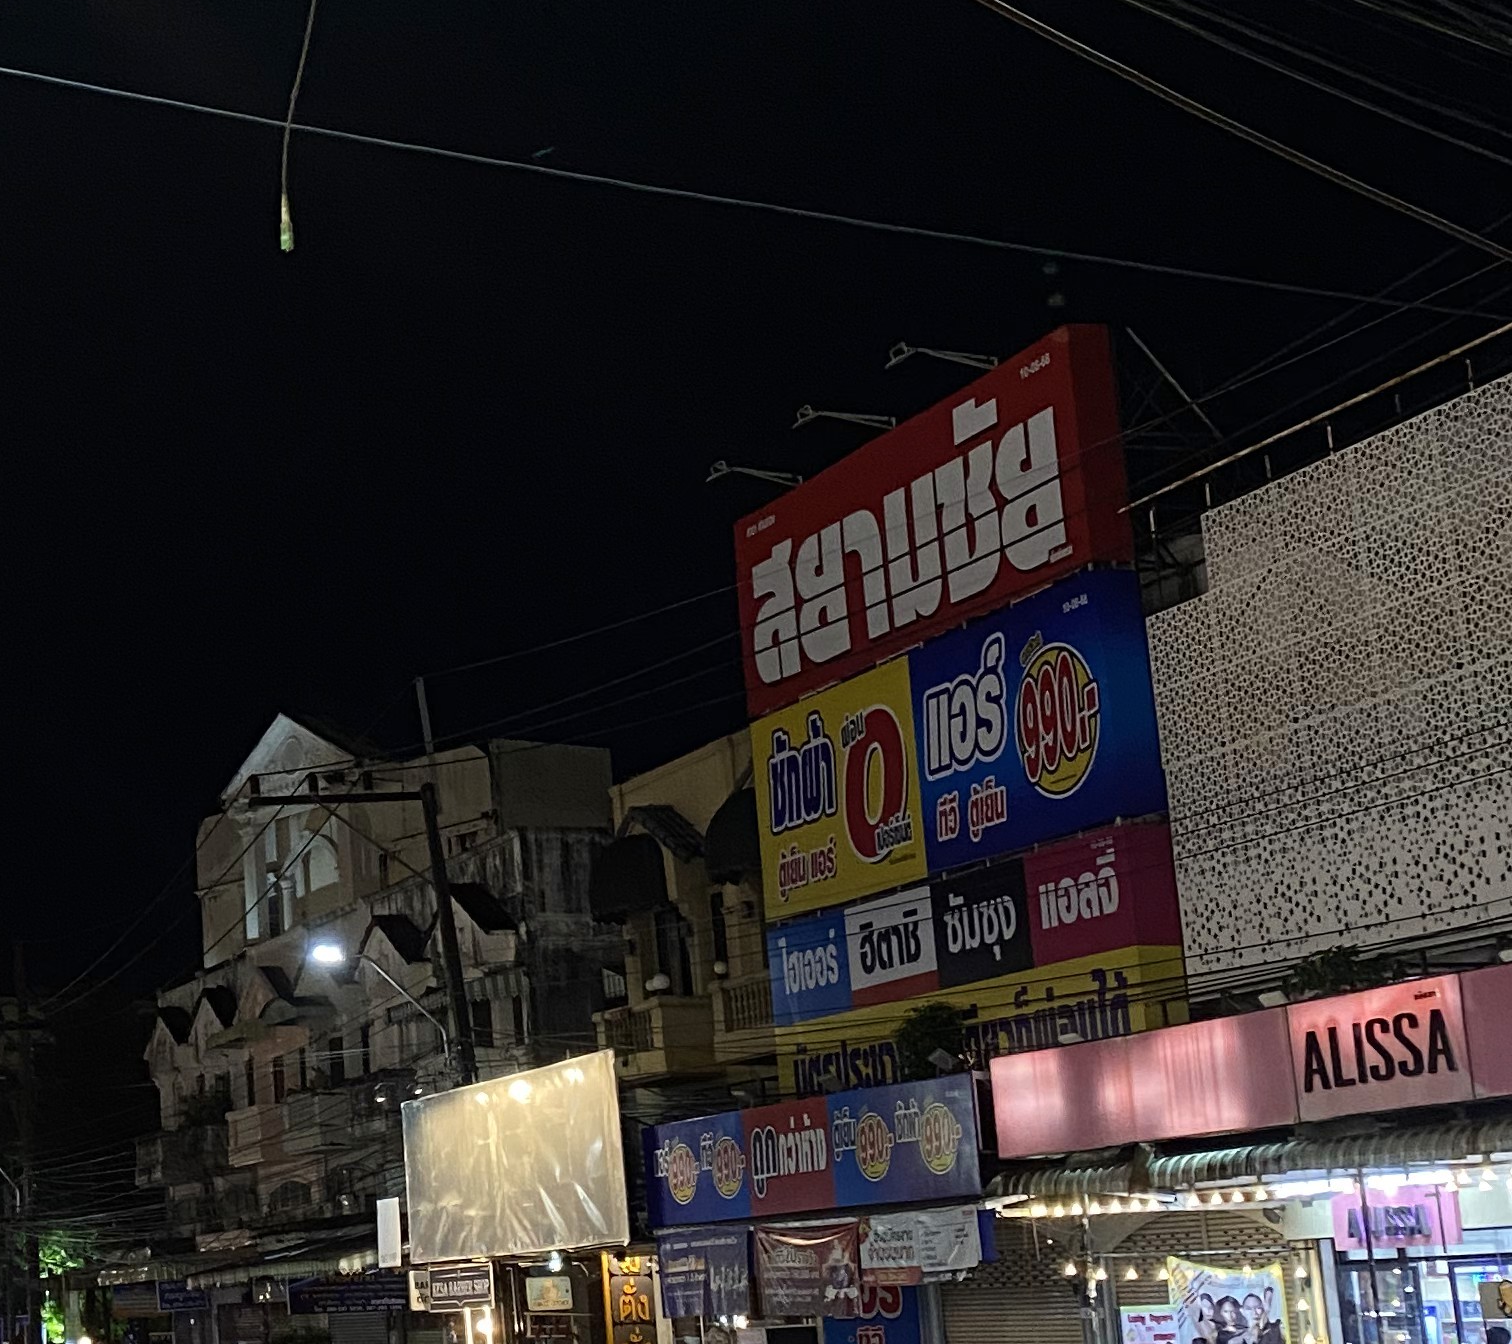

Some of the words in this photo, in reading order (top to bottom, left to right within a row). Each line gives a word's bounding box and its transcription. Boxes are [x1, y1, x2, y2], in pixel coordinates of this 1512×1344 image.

[751, 397, 1068, 685] สยามชัย
[923, 632, 1008, 782] แอร์
[844, 704, 907, 863] 0
[936, 790, 960, 843] ทีวี
[809, 835, 837, 882] แอร์
[1038, 848, 1120, 930] แอลจี
[859, 908, 921, 975] ฮิตาชิ
[943, 892, 1017, 962] ซัมซุง
[1304, 1009, 1458, 1093] ALISSA
